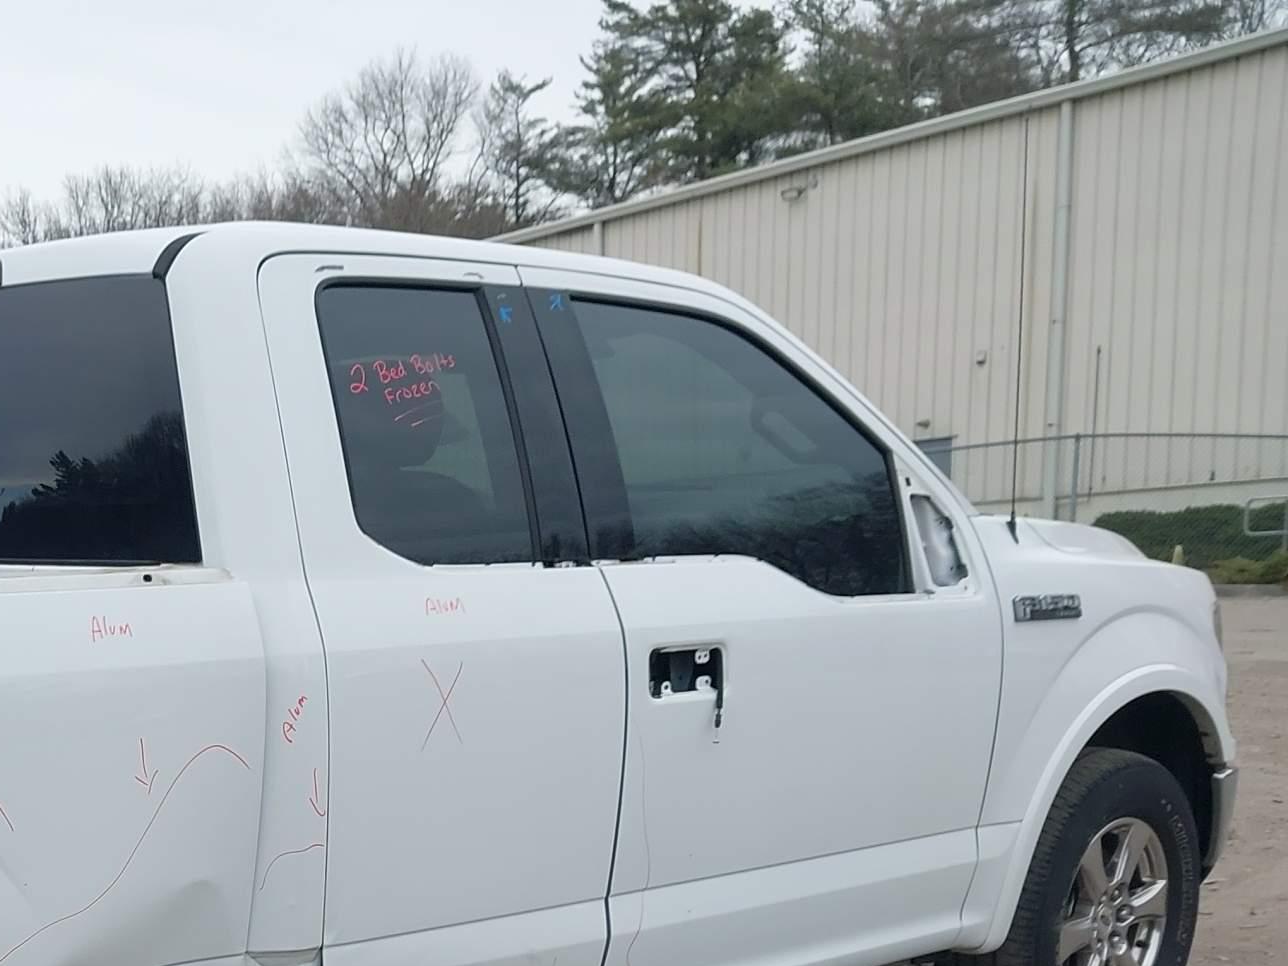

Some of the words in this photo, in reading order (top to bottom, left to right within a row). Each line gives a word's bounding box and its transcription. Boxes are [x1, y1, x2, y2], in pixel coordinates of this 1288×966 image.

[350, 364, 368, 394] 2
[373, 360, 407, 384] Bed
[410, 353, 456, 374] Bolts
[384, 380, 440, 405] Frozen
